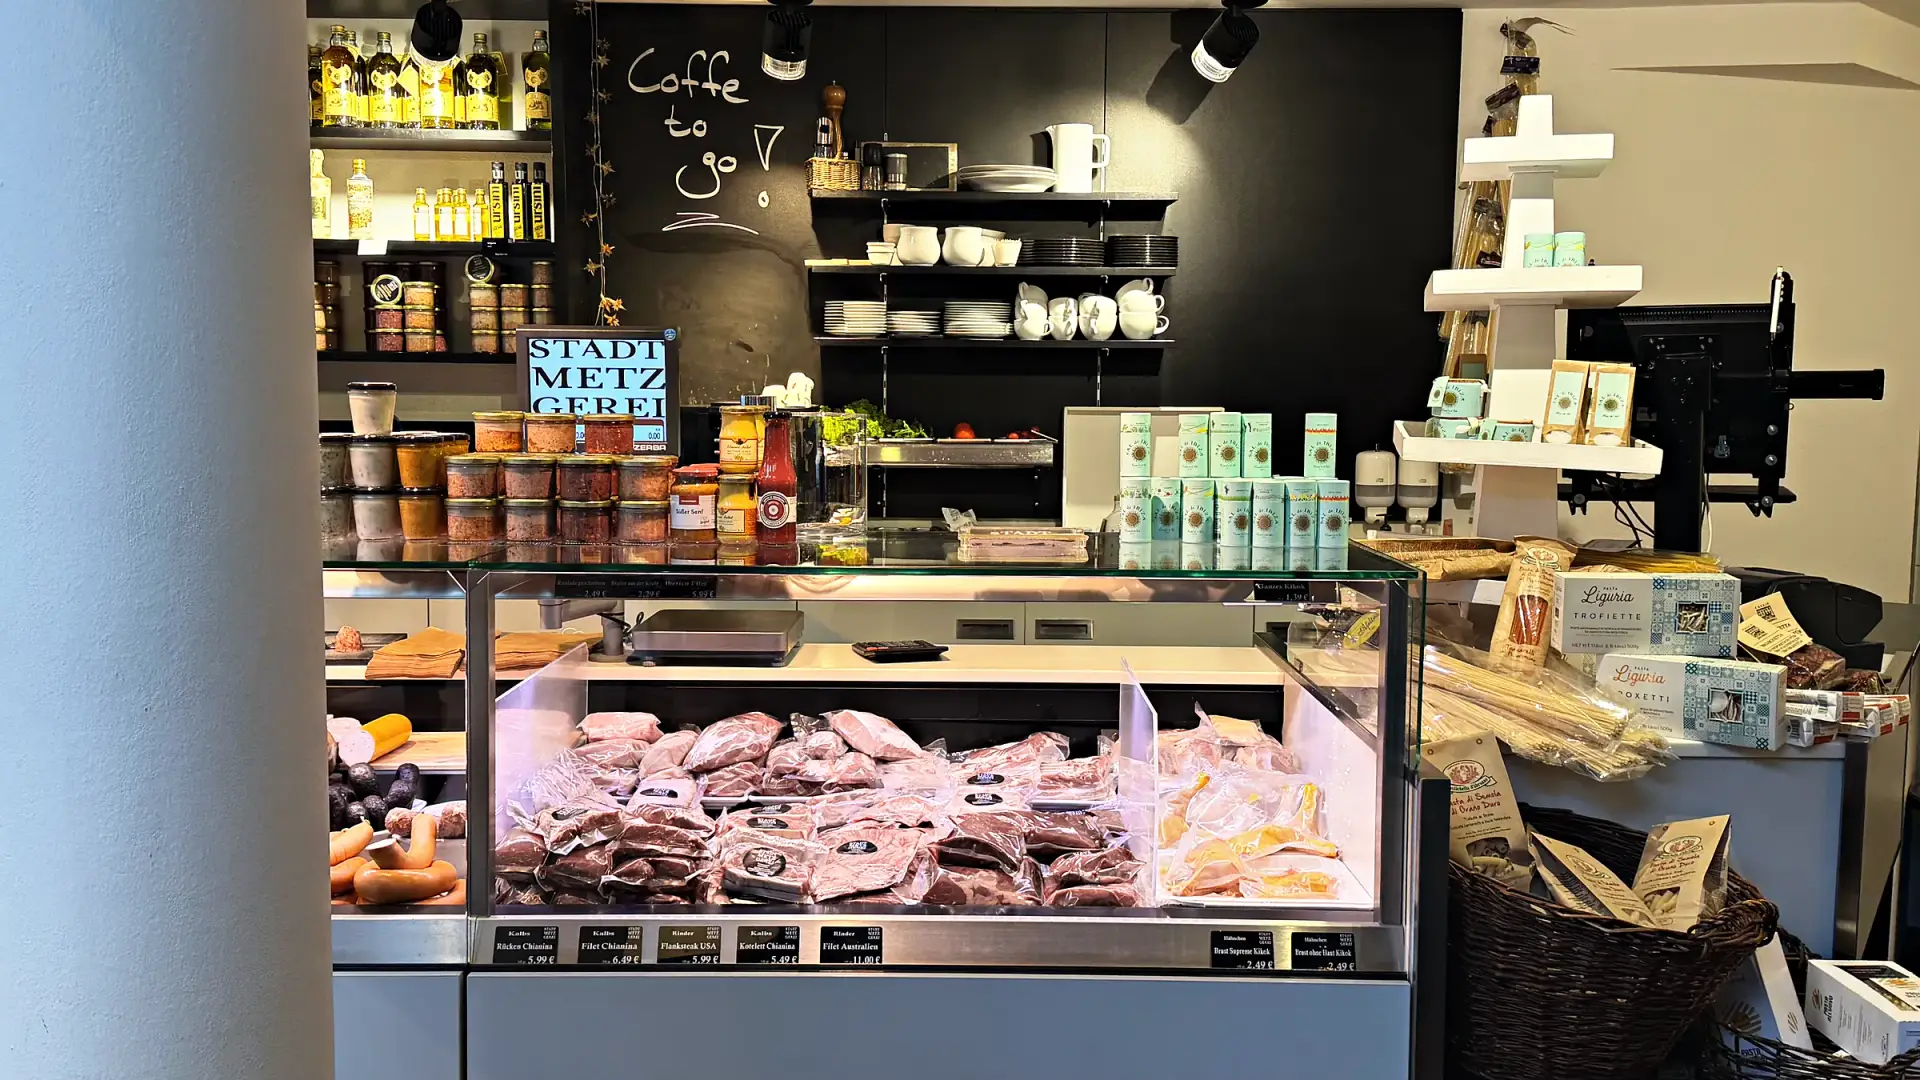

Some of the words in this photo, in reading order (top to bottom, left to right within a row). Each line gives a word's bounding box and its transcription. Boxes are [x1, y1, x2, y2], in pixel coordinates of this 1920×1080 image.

[627, 47, 750, 104] Coffe
[664, 104, 707, 137] to
[675, 151, 737, 199] go
[492, 186, 501, 223] ursini
[513, 186, 521, 223] ursini
[533, 186, 543, 223] ursini
[530, 339, 665, 359] STADT
[531, 367, 666, 390] METZ
[532, 397, 665, 418] GEREI
[1581, 585, 1635, 608] Liguria
[1574, 612, 1641, 621] TROFIETTE
[1613, 664, 1666, 687] Liguria
[1618, 691, 1670, 703] OXETTI
[1451, 798, 1465, 806] asta
[1475, 790, 1502, 801] Semola
[1481, 801, 1501, 809] Duro
[581, 942, 600, 950] Filet
[601, 942, 638, 950] Chianina
[660, 942, 699, 950] Flanksteak
[700, 942, 717, 950] USA
[739, 942, 765, 950] Kotelett
[766, 942, 796, 950] Chianina
[822, 942, 840, 950] Filet
[841, 942, 879, 950] Australien
